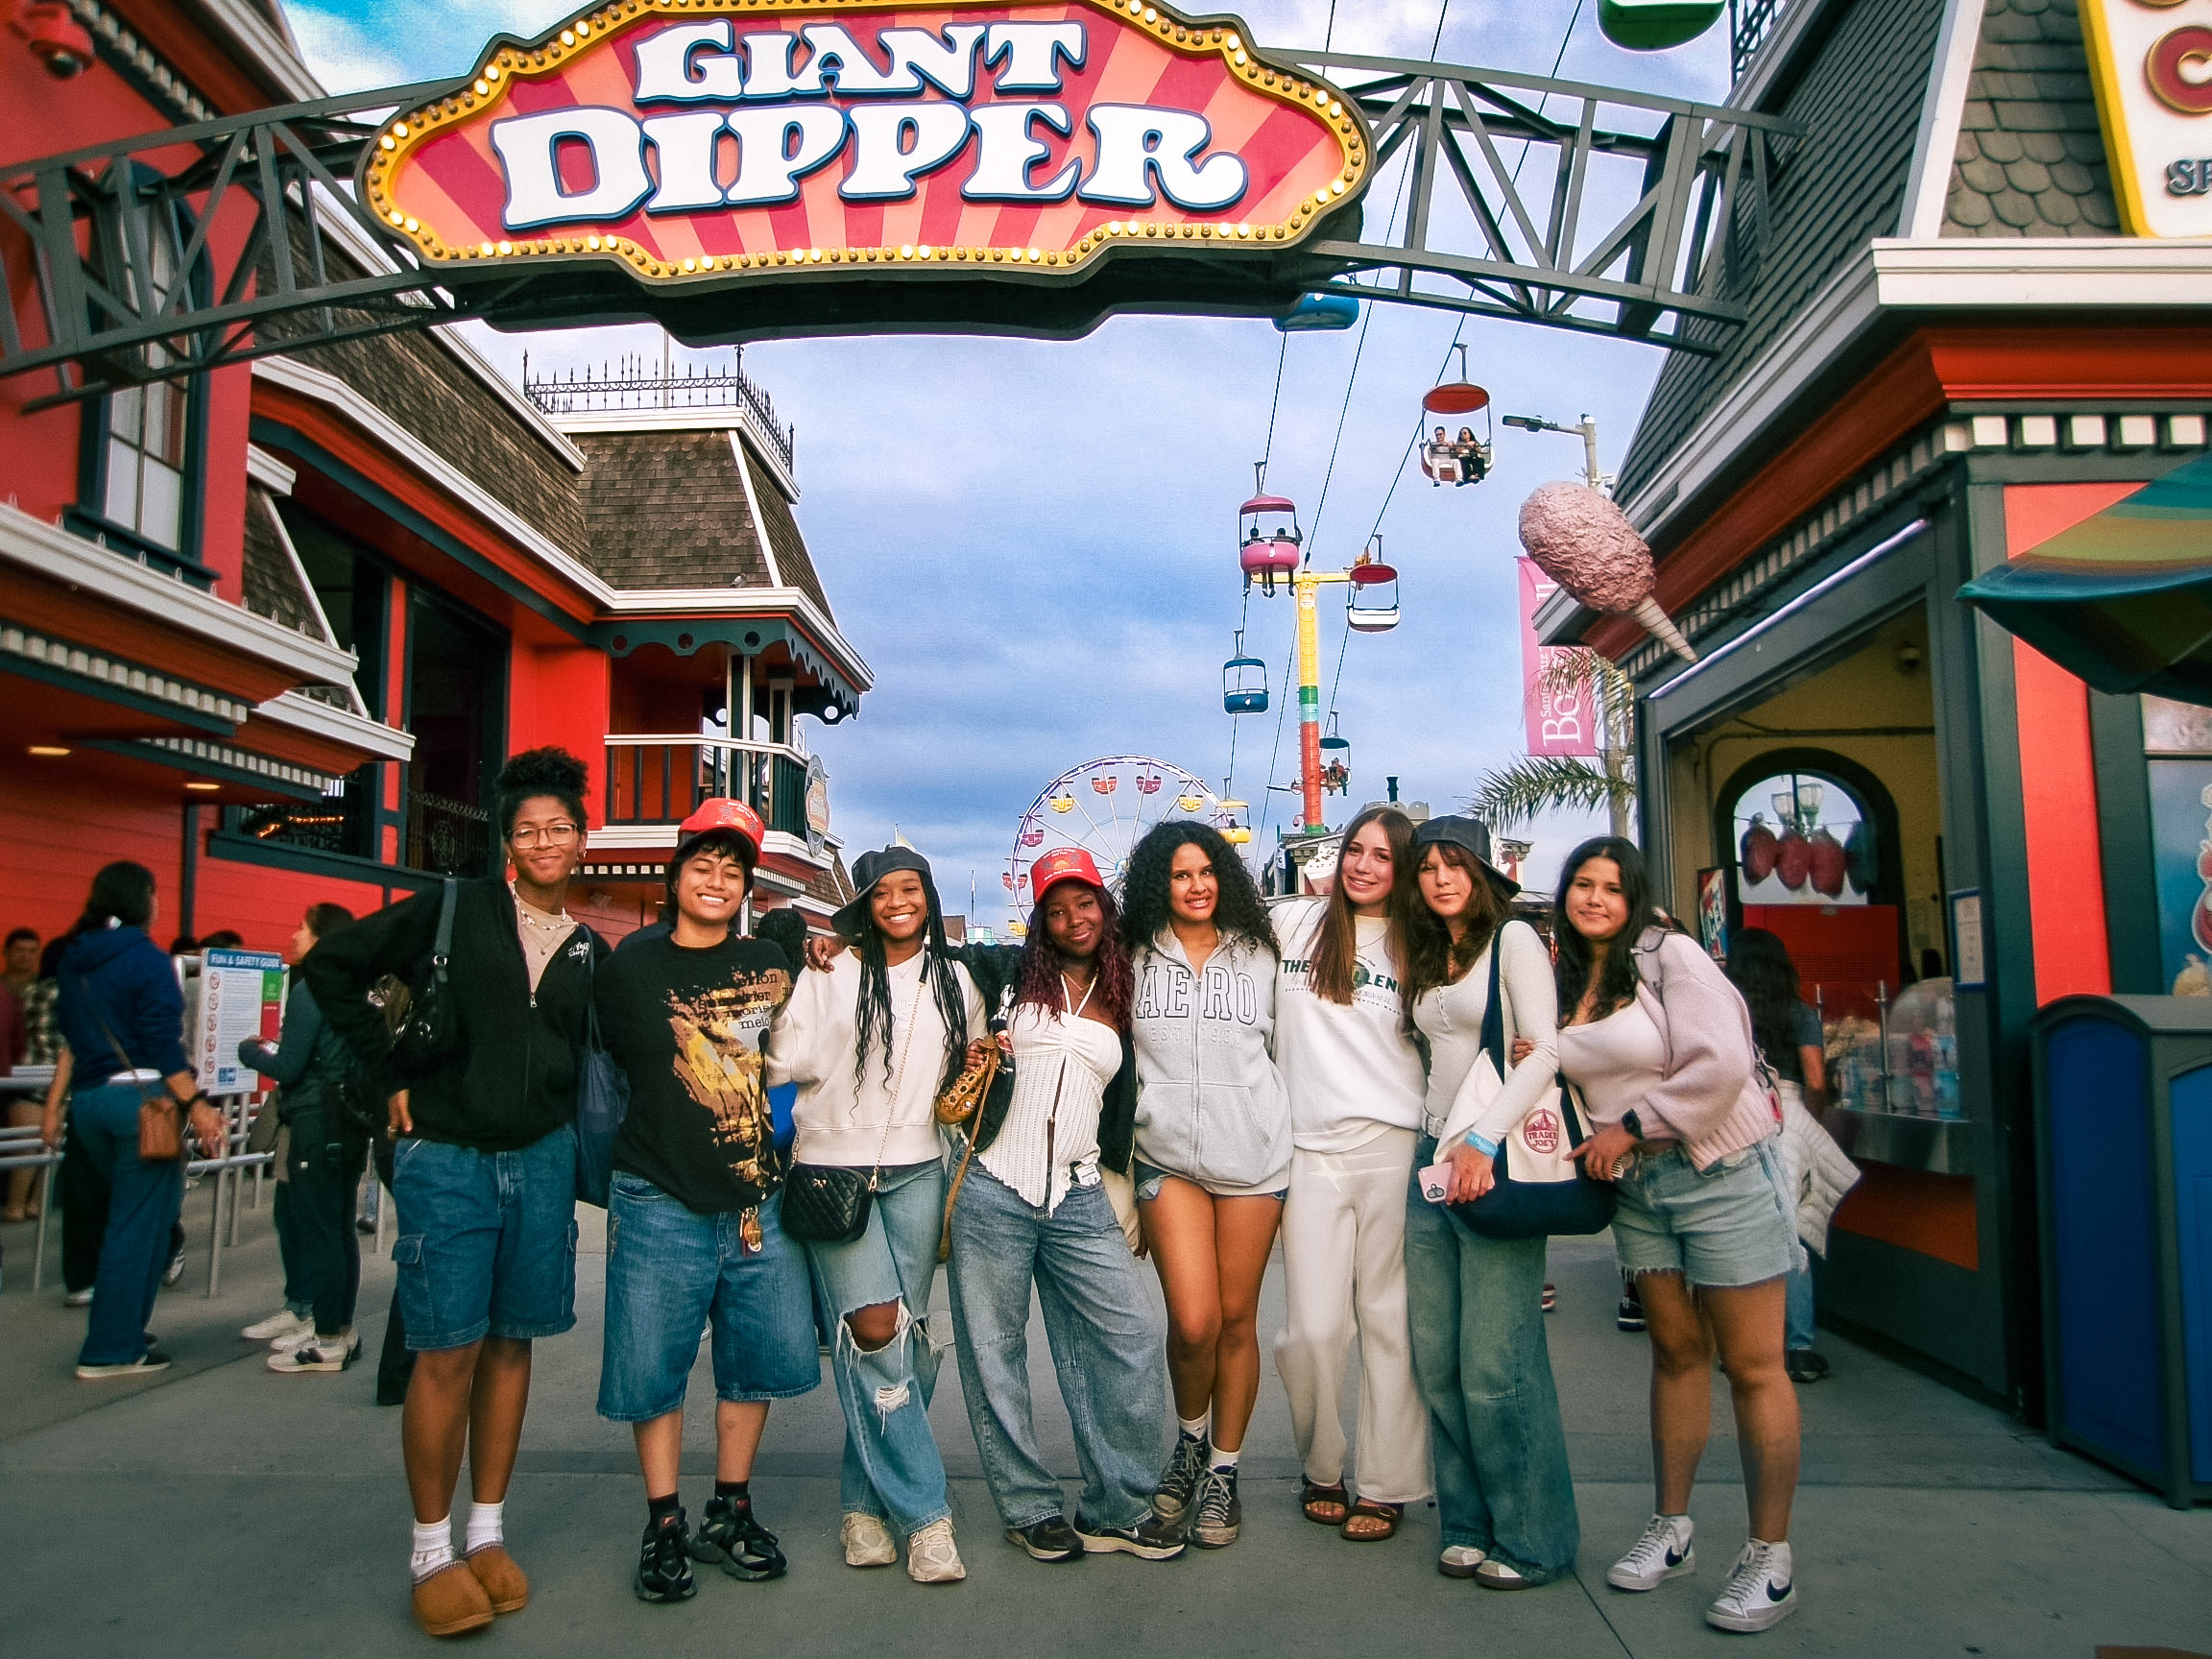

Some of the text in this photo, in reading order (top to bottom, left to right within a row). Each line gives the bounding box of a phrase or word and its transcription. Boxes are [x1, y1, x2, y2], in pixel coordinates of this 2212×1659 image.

[634, 19, 1087, 106] GIANT
[490, 101, 1249, 231] DIPPER
[235, 955, 260, 966] SAFETY
[260, 957, 280, 968] GUIDE
[1282, 959, 1311, 974] THE
[1136, 965, 1257, 1026] AERO
